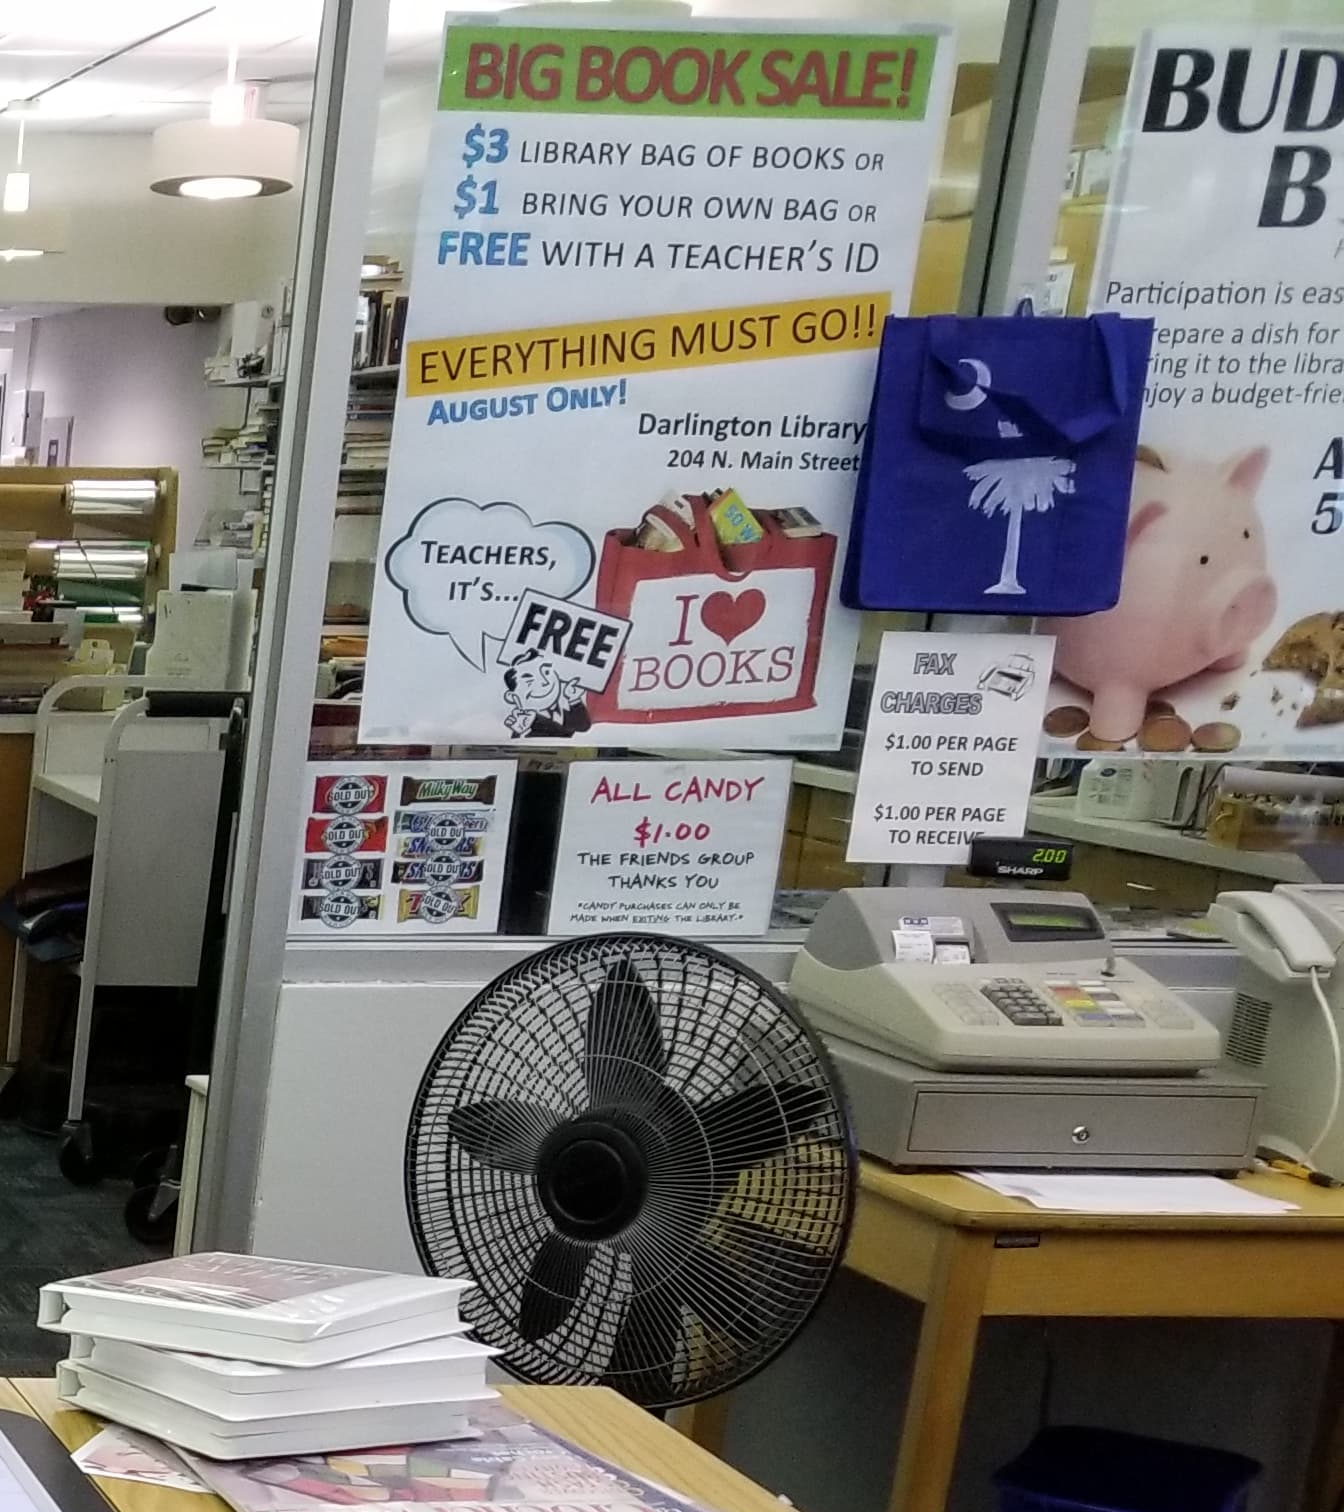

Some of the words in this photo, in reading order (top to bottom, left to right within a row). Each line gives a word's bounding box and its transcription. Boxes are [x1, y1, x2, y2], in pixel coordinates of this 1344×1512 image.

[464, 42, 564, 101] BIG
[576, 46, 751, 106] BOOK
[756, 48, 918, 108] SALE!
[461, 123, 509, 168] $3
[519, 140, 632, 167] LIBRARY
[640, 143, 696, 168] BAG
[707, 144, 744, 168] OF
[752, 146, 845, 171] BOOKS
[855, 152, 885, 172] OR
[453, 174, 500, 219] $1
[522, 192, 608, 217] BRING
[618, 194, 692, 219] YOUR
[703, 197, 773, 221] OWN
[783, 198, 839, 222] BAG
[848, 204, 877, 222] OR
[438, 231, 531, 267] FREE
[541, 241, 624, 268] WITH
[633, 244, 655, 268] A
[667, 241, 833, 273] TEACHER'S
[845, 242, 879, 274] ID
[1106, 280, 1266, 309] Participation
[1275, 282, 1294, 305] is
[420, 328, 657, 385] EVERYTHING
[670, 314, 781, 358] MUST
[792, 303, 877, 346] GO!!
[1232, 327, 1243, 344] a
[1252, 321, 1299, 344] dish
[1307, 322, 1339, 345] for
[1195, 353, 1210, 374] it
[1217, 354, 1239, 374] to
[1249, 353, 1286, 374] the
[1191, 388, 1204, 404] a
[428, 391, 538, 426] AUGUST
[638, 412, 773, 442] Darlington
[781, 414, 869, 444] Library
[667, 449, 706, 470] 204
[712, 450, 733, 470] N.
[740, 449, 794, 471] Main
[798, 450, 859, 472] Street
[420, 539, 557, 571] TEACHERS,
[669, 595, 698, 645] I
[514, 600, 618, 671] FREE
[628, 645, 796, 693] BOOKS
[913, 652, 957, 676] FAX
[880, 691, 983, 715] CHARGES
[885, 733, 932, 751] $1.00
[936, 736, 967, 751] PER
[973, 737, 1018, 752] PAGE
[911, 761, 933, 776] TO
[938, 762, 983, 776] SEND
[328, 790, 351, 801] SOLD
[590, 776, 652, 804] ALL
[665, 776, 765, 804] CANDY
[874, 804, 920, 821] $1.00
[925, 806, 955, 821] PER
[961, 807, 1006, 822] PAGE
[324, 830, 346, 841] SOLD
[634, 816, 711, 848] $1.00
[889, 830, 911, 844] TO
[577, 852, 611, 866] THE
[620, 851, 690, 866] FRIENDS
[698, 852, 755, 866] GROUP
[998, 865, 1043, 875] SHARP
[319, 868, 342, 880] SOLD
[608, 873, 677, 890] THANKS
[684, 874, 719, 889] YOU
